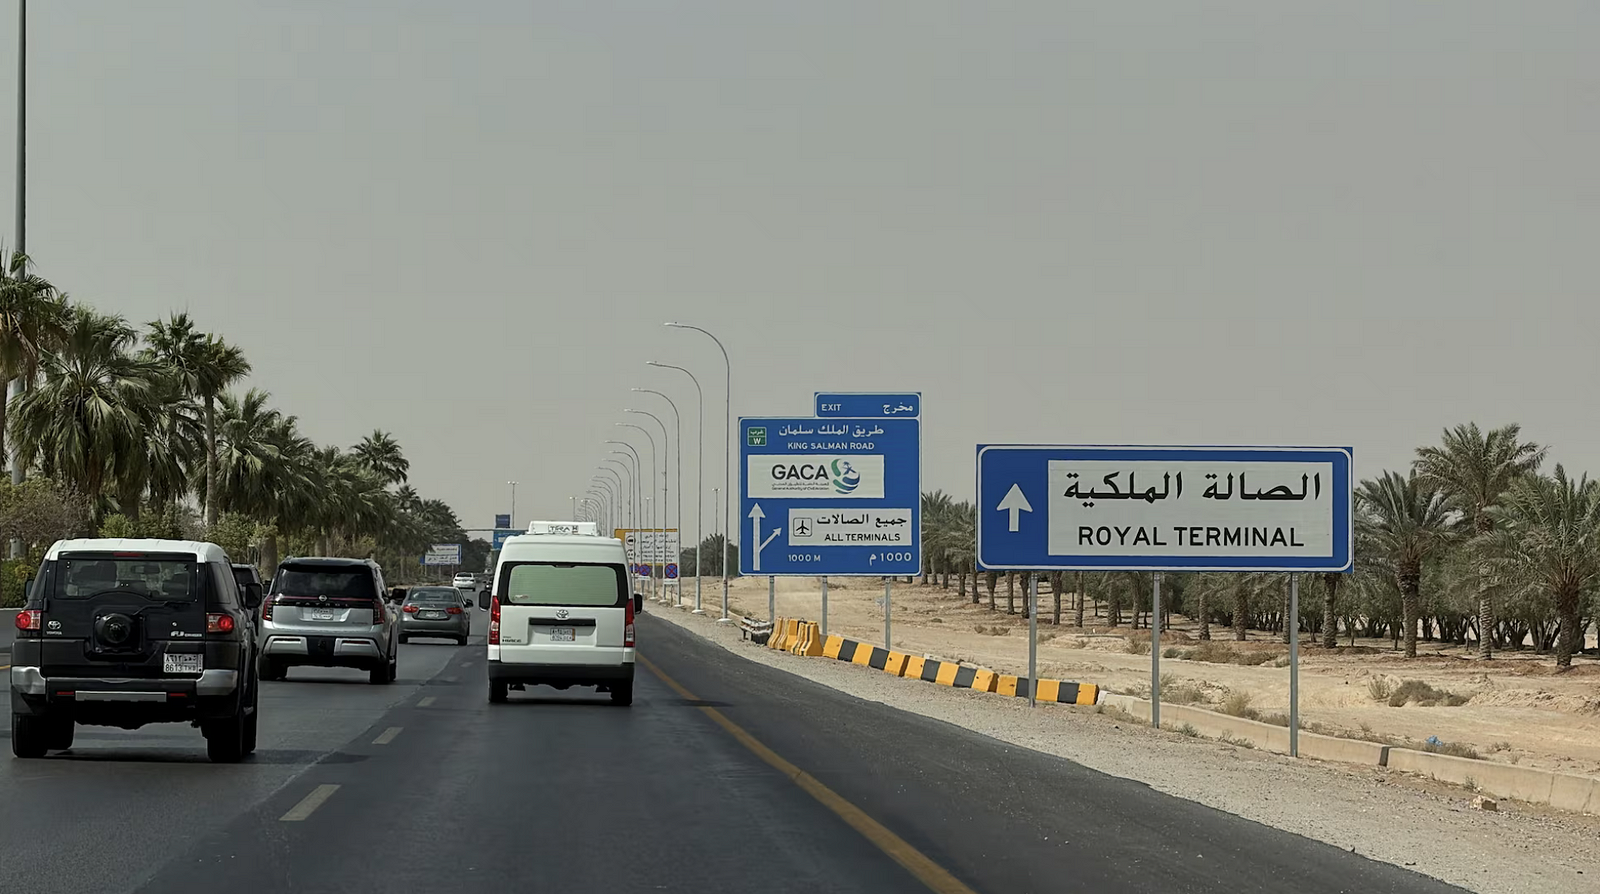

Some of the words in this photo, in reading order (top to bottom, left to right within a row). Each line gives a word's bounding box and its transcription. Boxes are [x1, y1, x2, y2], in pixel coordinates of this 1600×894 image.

[821, 403, 842, 412] EXIT
[882, 402, 914, 414] مخرج
[778, 424, 814, 436] سلمان
[818, 424, 849, 435] الملك
[852, 425, 884, 438] طريق
[771, 464, 830, 480] GACA
[1063, 471, 1182, 508] الملكية
[1202, 471, 1321, 500] الصالة
[816, 514, 869, 525] الصالات
[875, 516, 907, 528] جميع
[846, 533, 901, 541] TERMINALS
[1078, 526, 1167, 546] ROYAL
[1174, 526, 1304, 546] TERMINAL
[869, 554, 877, 566] م
[880, 552, 912, 562] 1000
